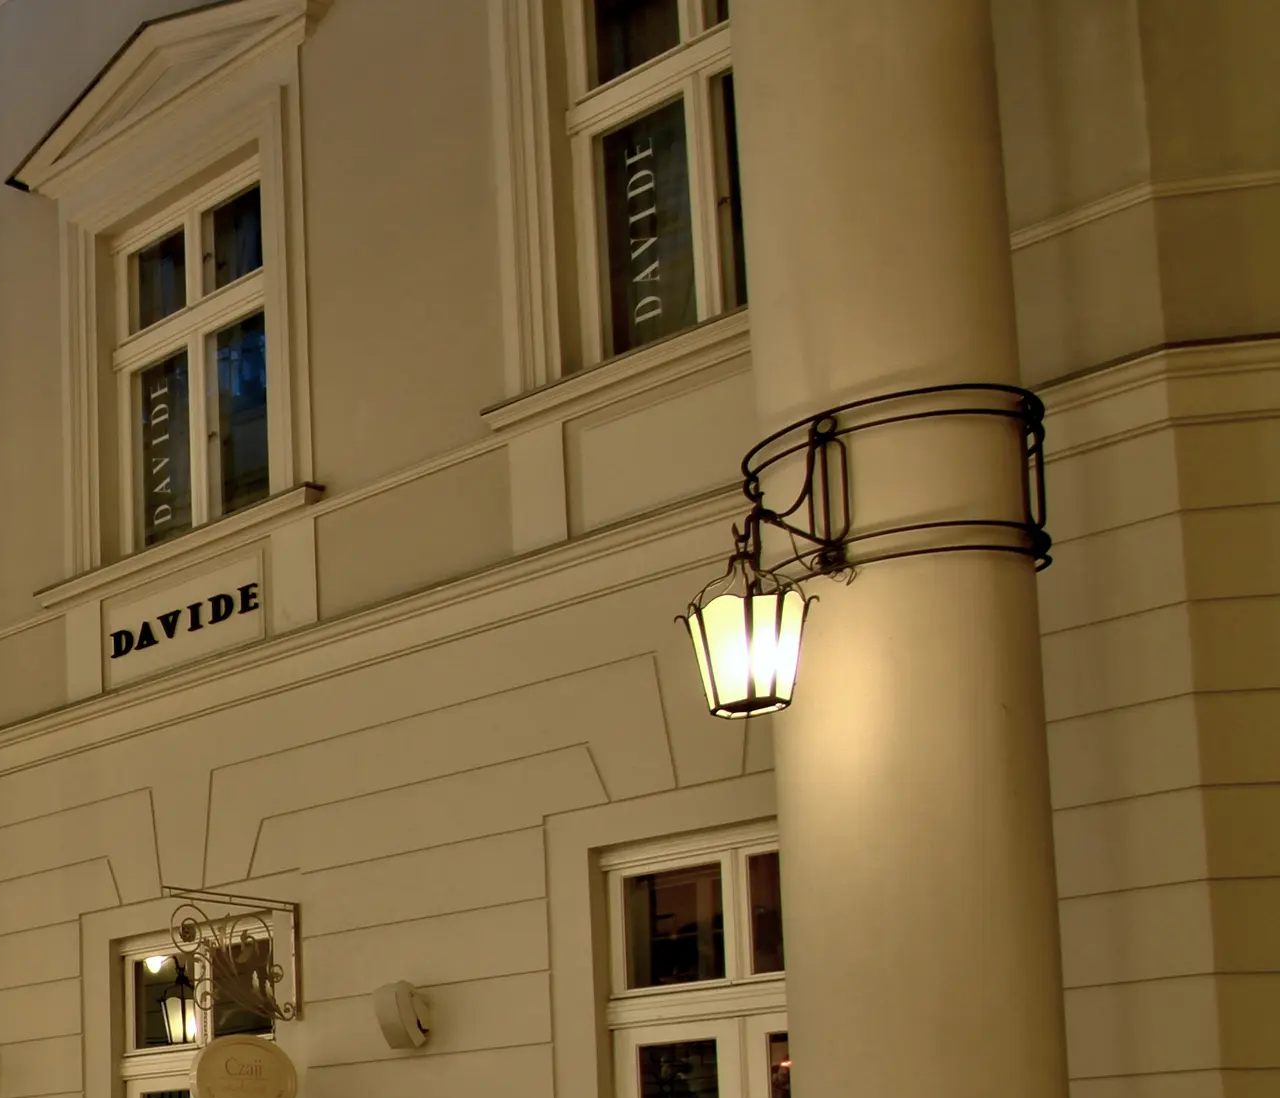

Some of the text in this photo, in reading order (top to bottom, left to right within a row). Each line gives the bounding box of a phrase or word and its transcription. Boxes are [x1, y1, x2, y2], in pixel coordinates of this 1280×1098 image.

[625, 138, 661, 324] DAVIDE
[151, 378, 171, 525] DAVIDE
[110, 582, 259, 659] DAVIDE
